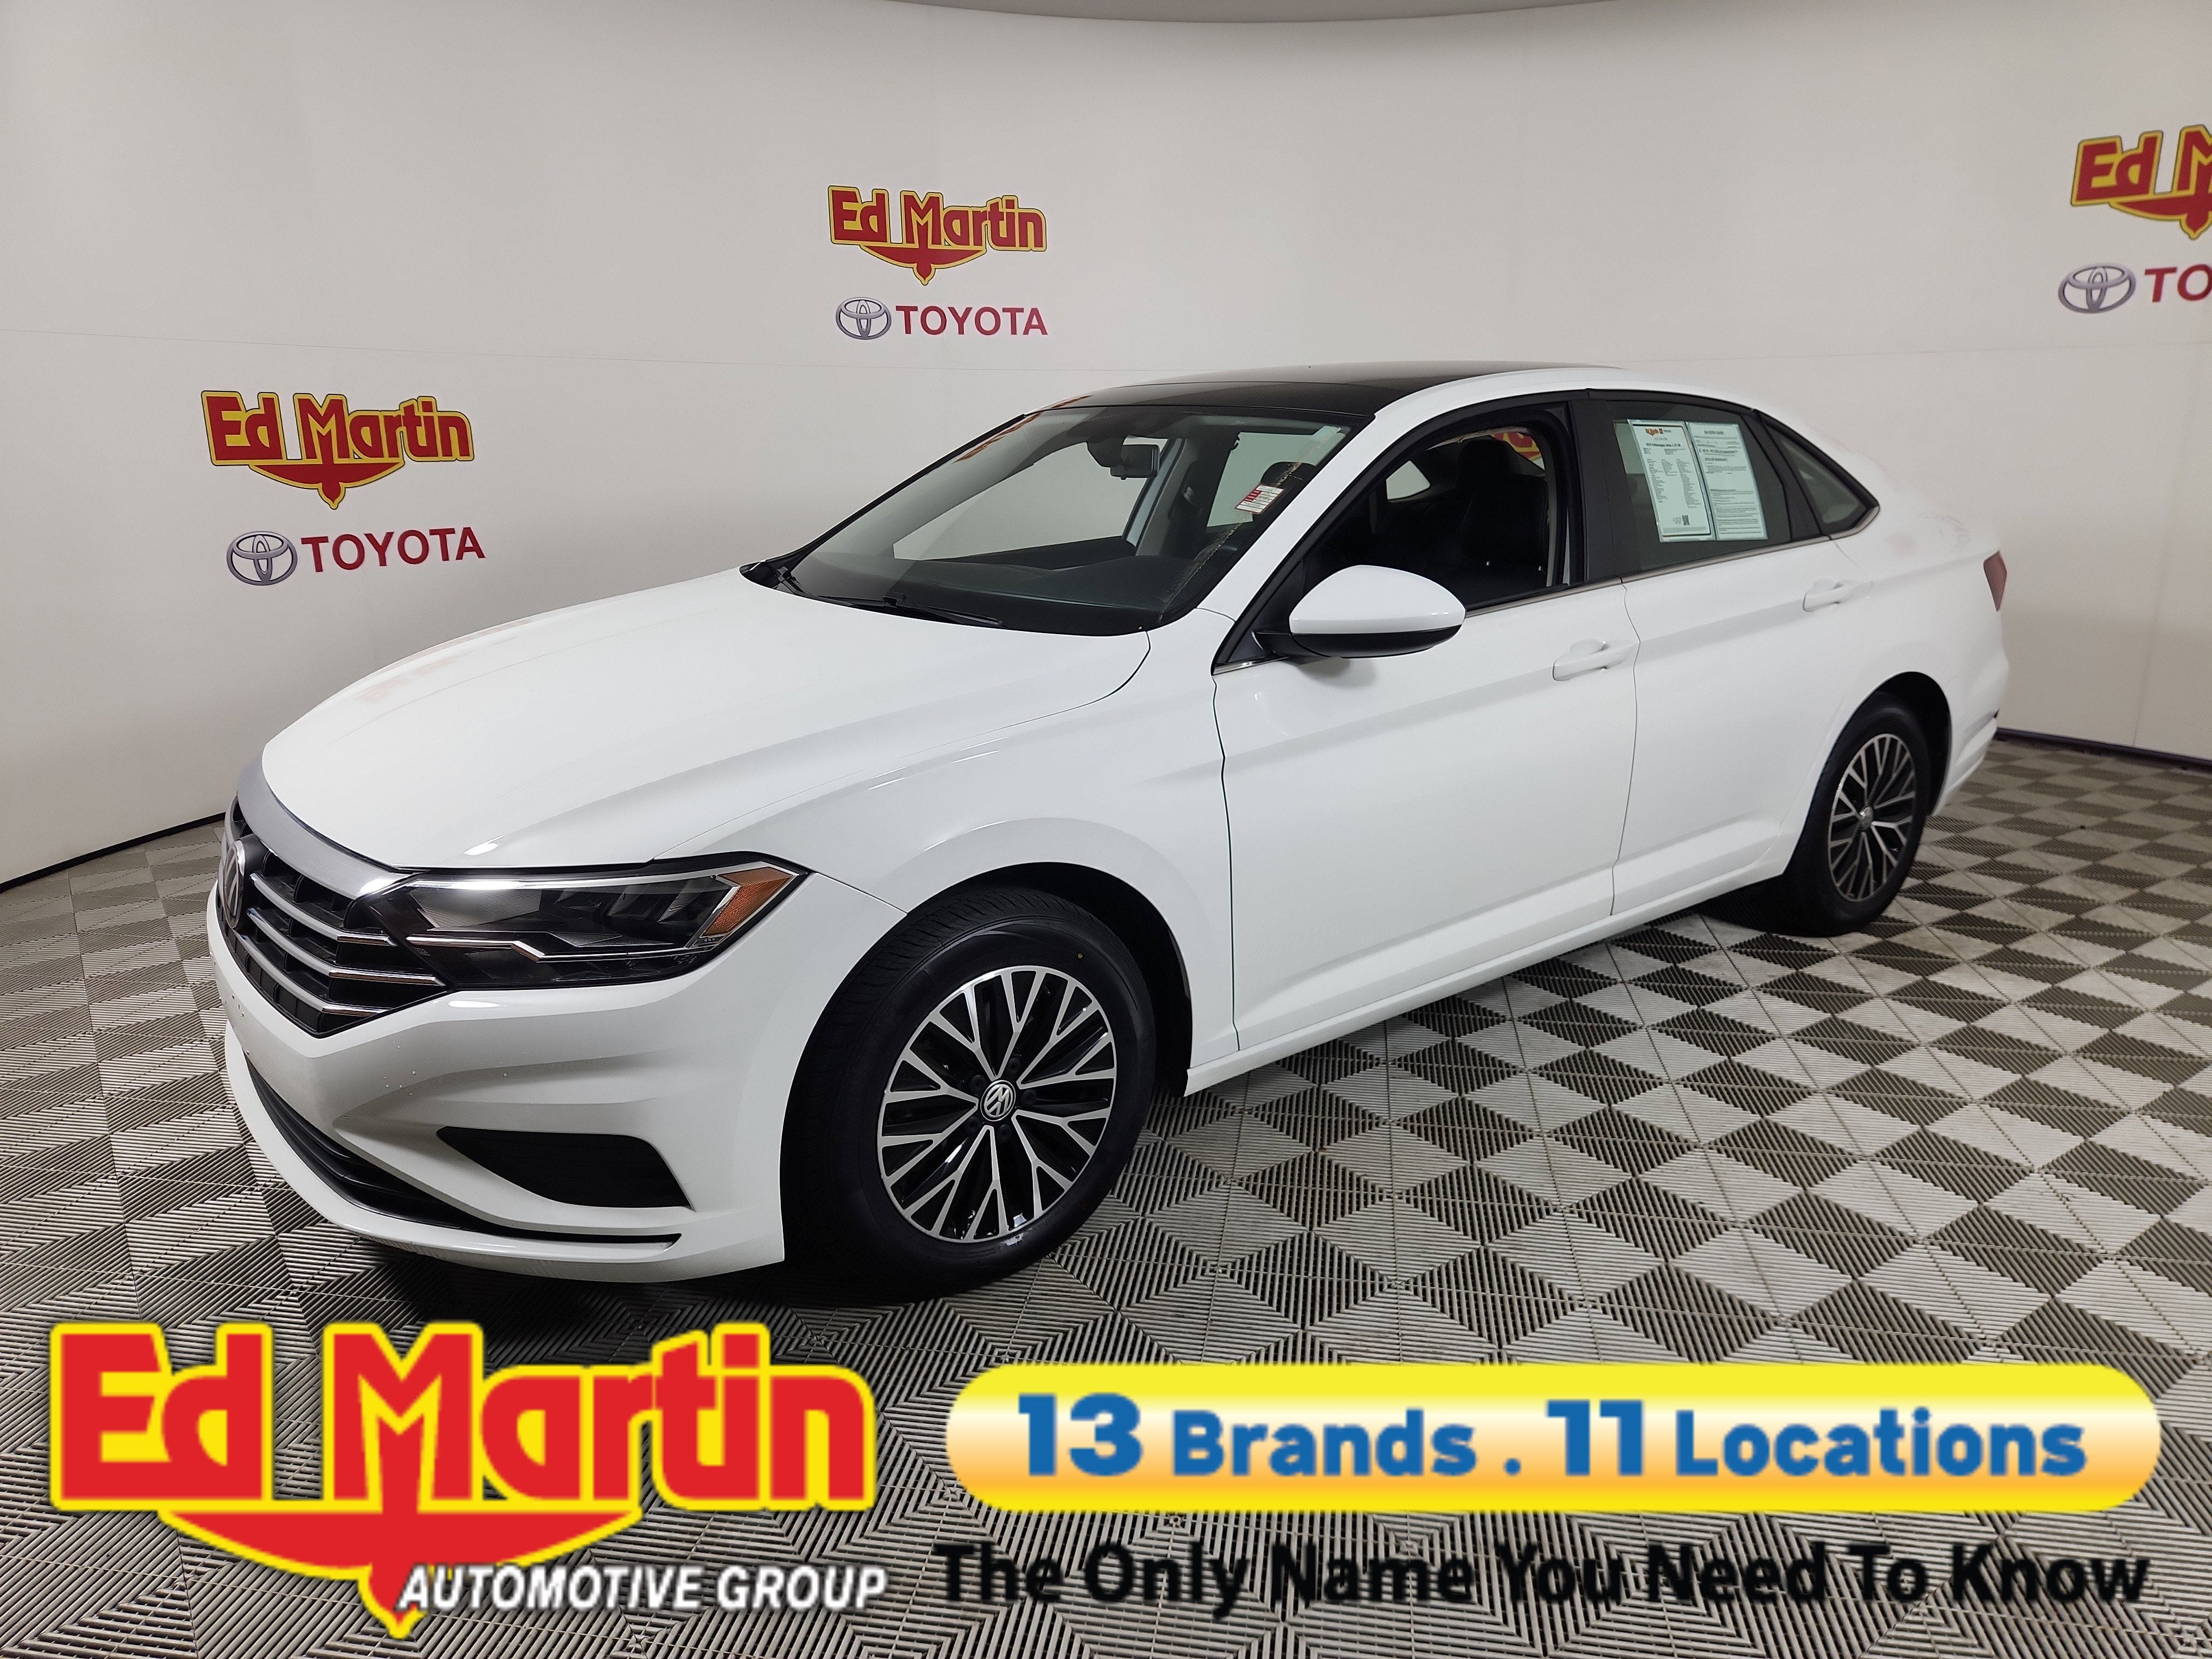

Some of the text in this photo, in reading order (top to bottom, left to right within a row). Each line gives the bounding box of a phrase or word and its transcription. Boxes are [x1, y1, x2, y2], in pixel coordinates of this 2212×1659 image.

[2074, 133, 2159, 203] Ed
[830, 188, 1045, 249] Ed Martin
[895, 305, 1048, 336] TOYOTA
[204, 394, 472, 461] Ed Martin
[300, 526, 486, 573] TOYOTA
